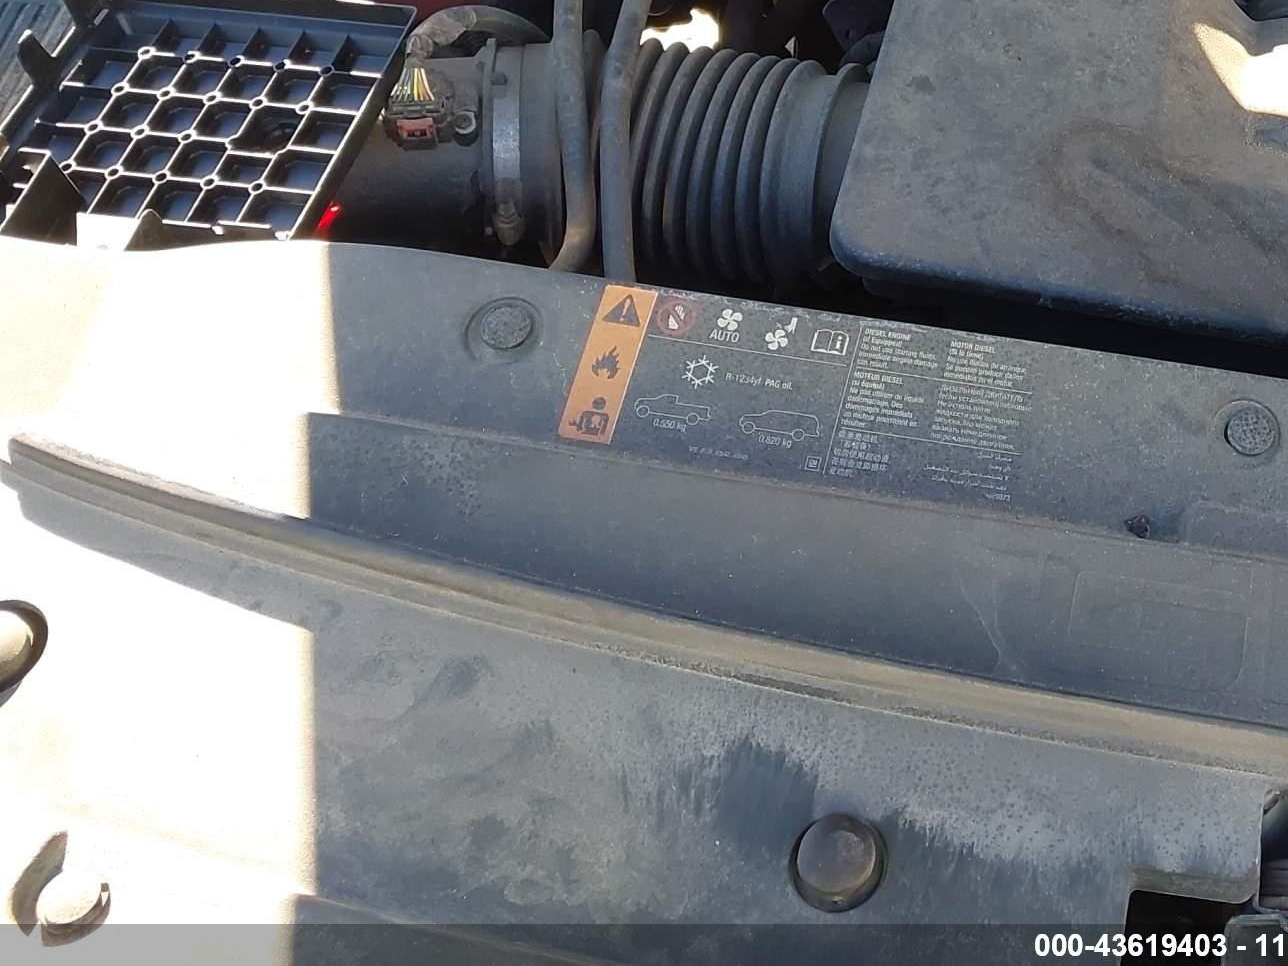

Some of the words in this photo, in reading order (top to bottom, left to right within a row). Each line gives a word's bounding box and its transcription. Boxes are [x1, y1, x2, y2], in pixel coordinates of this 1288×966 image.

[709, 329, 739, 342] AUTO
[865, 328, 887, 337] DIESEL
[888, 331, 911, 340] ENGINE
[725, 372, 761, 386] R-1234yf
[764, 378, 781, 388] PAG
[781, 380, 794, 390] oil.
[881, 375, 904, 384] DIESEL
[653, 418, 675, 429] 0.550
[676, 422, 688, 432] kg
[758, 433, 781, 445] 0.820
[781, 437, 793, 449] kg
